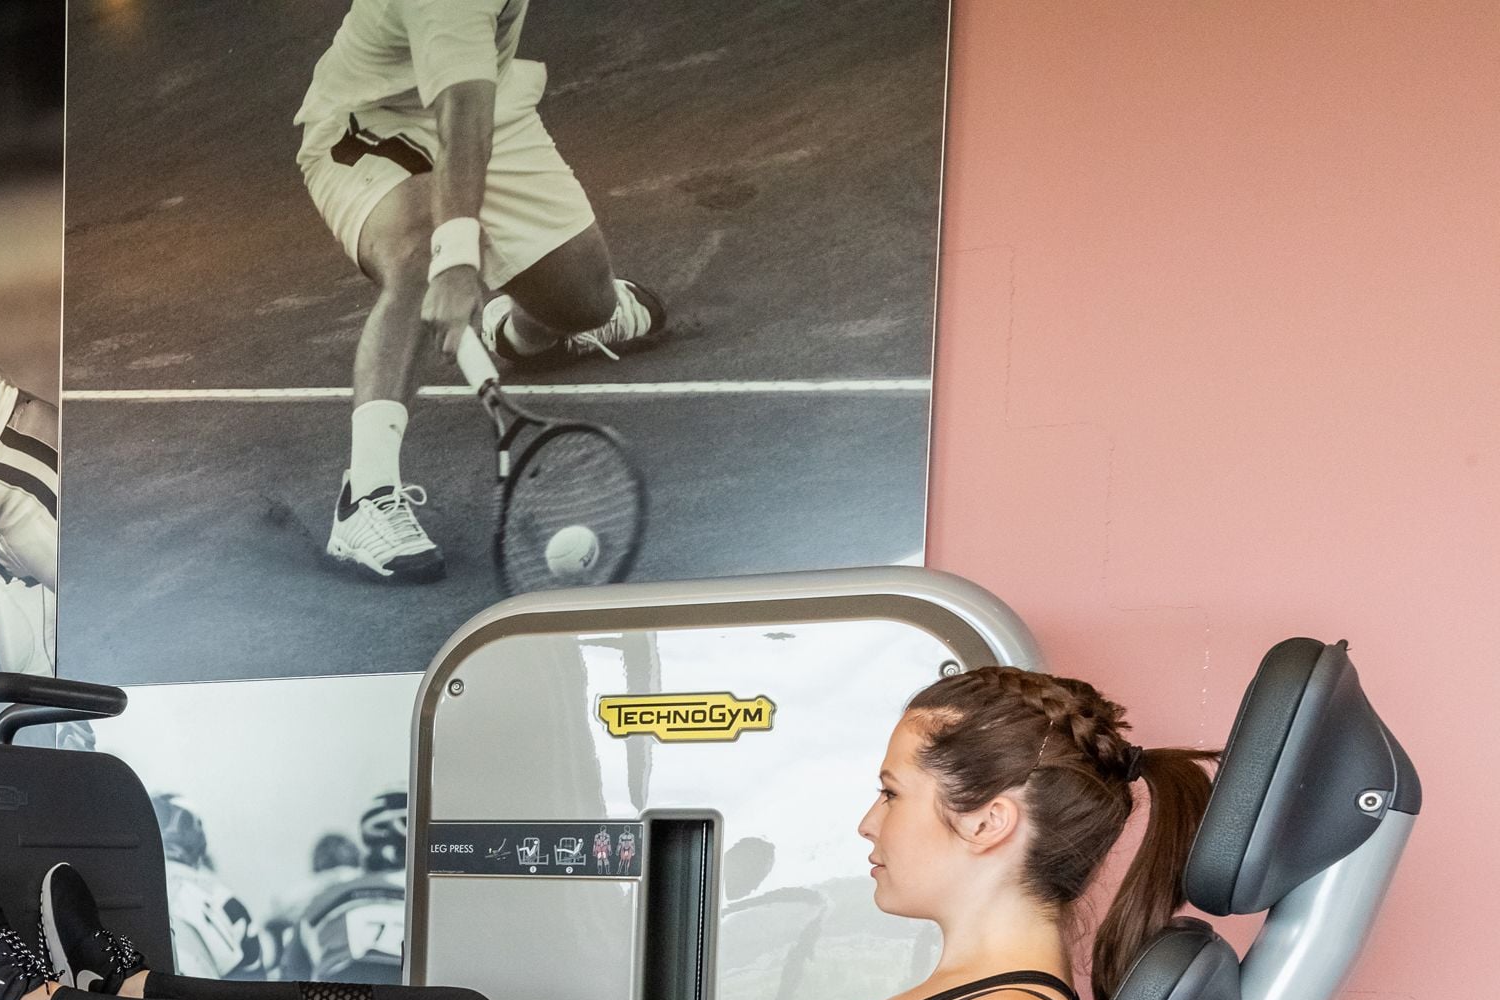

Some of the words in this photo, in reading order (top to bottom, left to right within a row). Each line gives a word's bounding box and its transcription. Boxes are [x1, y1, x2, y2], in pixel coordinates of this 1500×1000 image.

[606, 701, 763, 732] TECHNOGYM
[430, 844, 447, 853] LEG
[450, 844, 474, 854] PRESS
